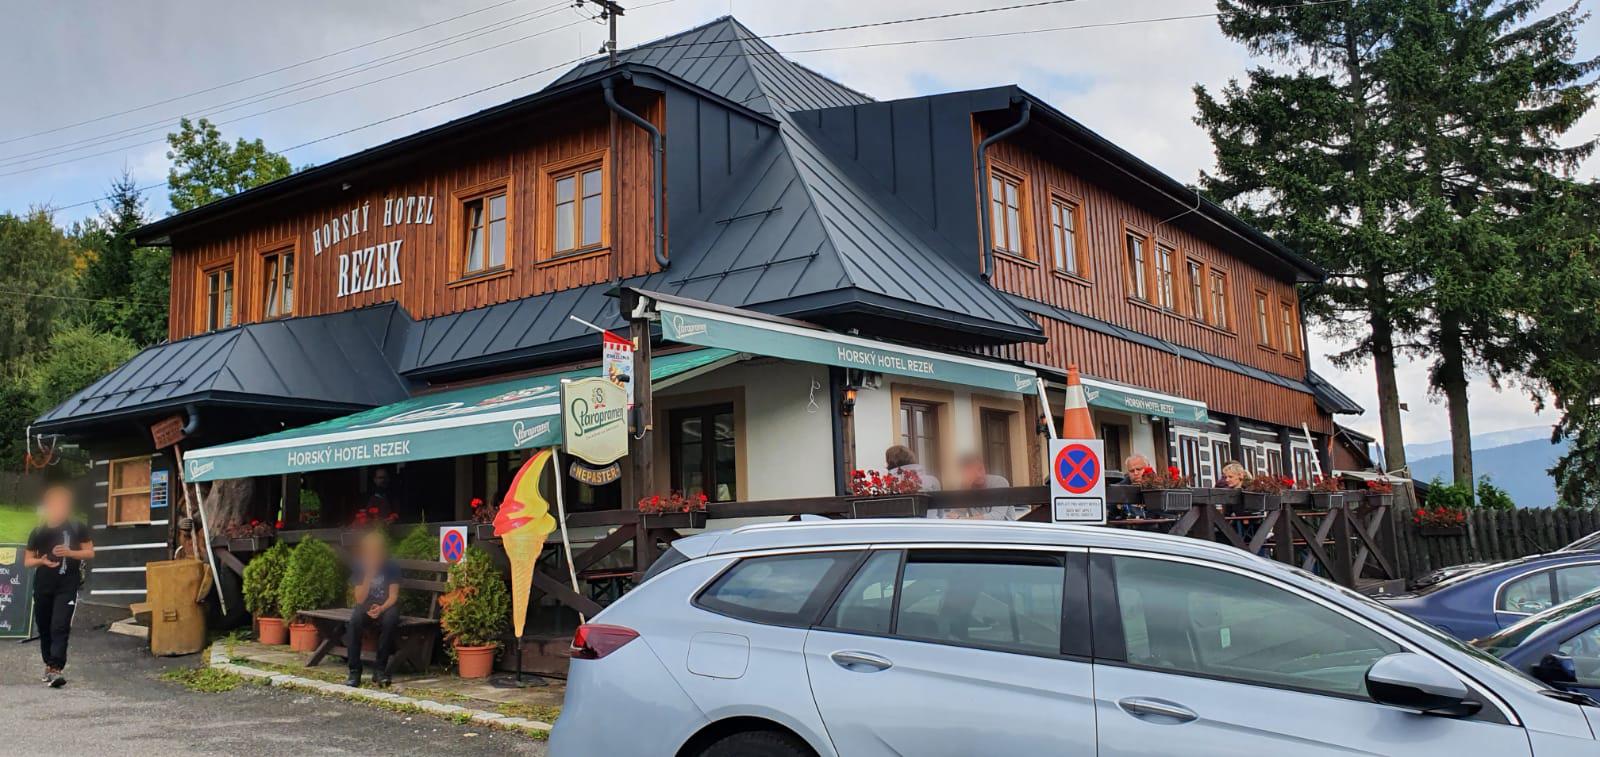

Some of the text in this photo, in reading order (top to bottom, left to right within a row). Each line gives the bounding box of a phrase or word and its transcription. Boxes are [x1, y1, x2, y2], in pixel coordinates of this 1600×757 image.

[312, 196, 434, 256] HORSKÝ HOTEL
[337, 239, 404, 297] REZEK
[837, 346, 935, 375] HORSKÝ HOTEL REZEK
[571, 398, 625, 437] Staropramen
[288, 440, 410, 467] HORSKÝ HOTEL REZEK
